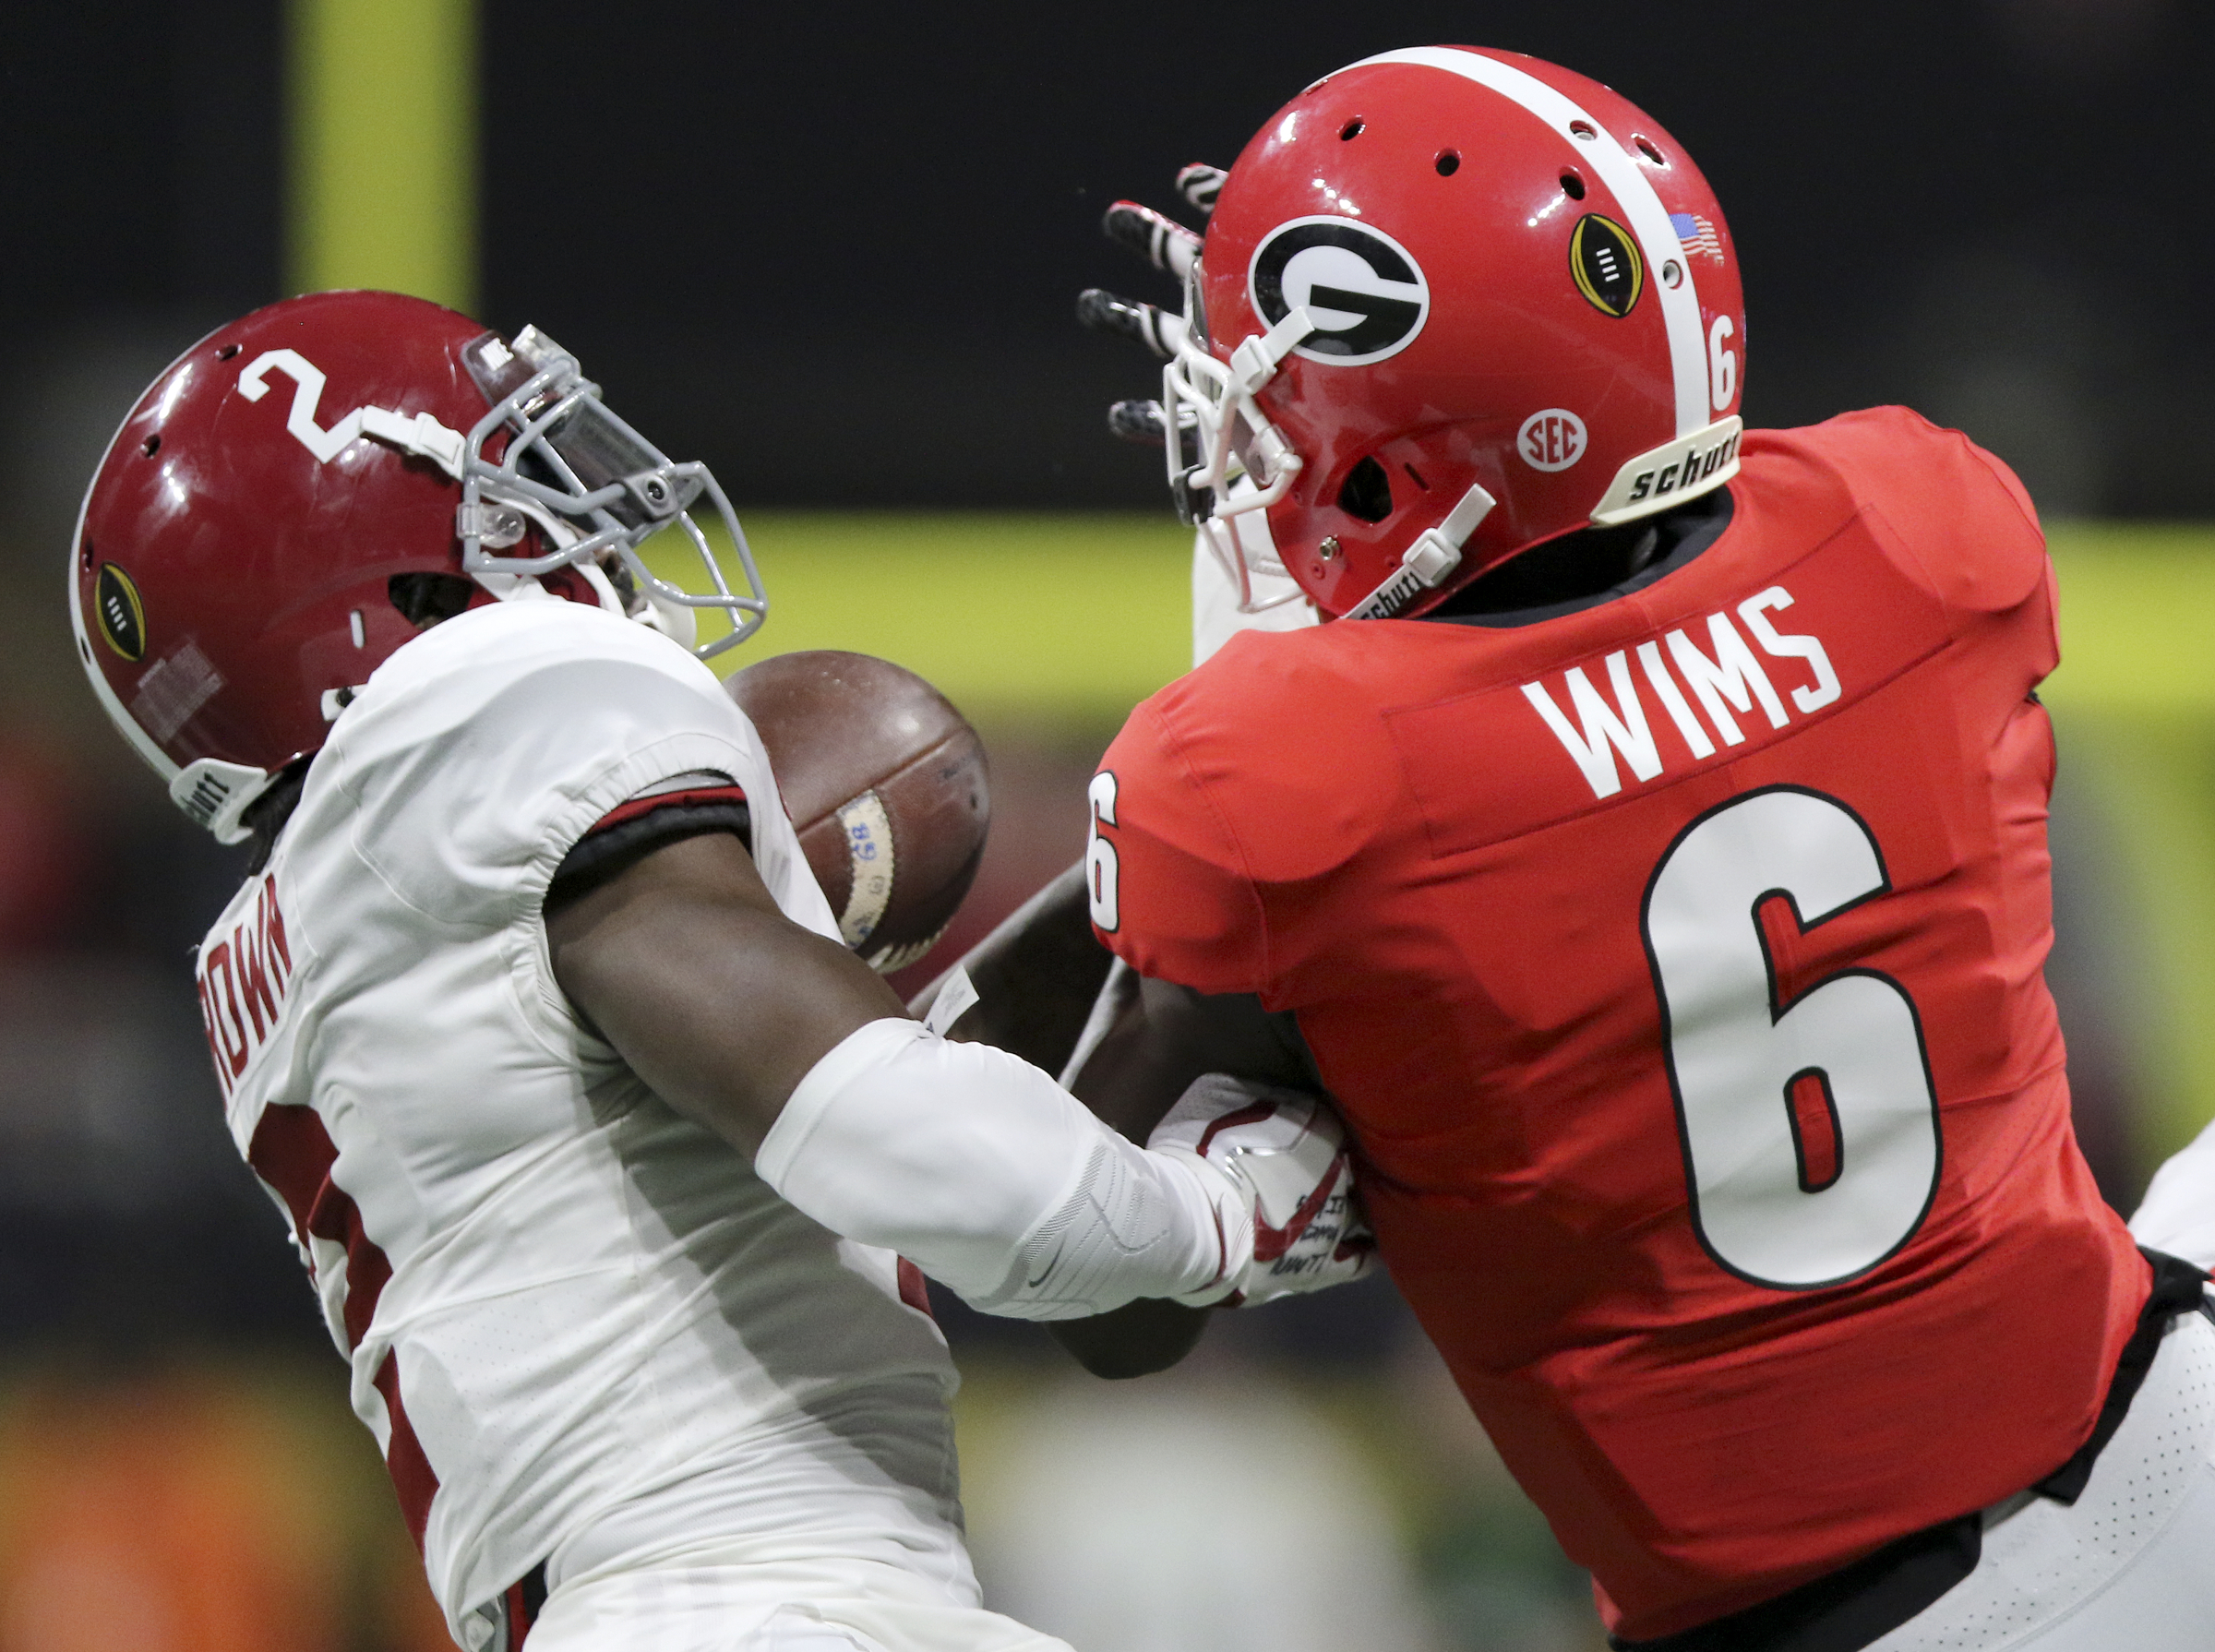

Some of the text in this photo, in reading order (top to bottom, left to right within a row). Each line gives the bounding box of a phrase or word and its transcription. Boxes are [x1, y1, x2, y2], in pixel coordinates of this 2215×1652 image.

[237, 348, 364, 464] 2
[1708, 315, 1736, 412] 6
[1526, 416, 1578, 464] SEC
[1629, 431, 1740, 501] schutt
[1520, 585, 1843, 800] WIMS
[1084, 769, 1120, 934] 6
[197, 871, 293, 1116] ROWN
[1639, 784, 1944, 1290] 6
